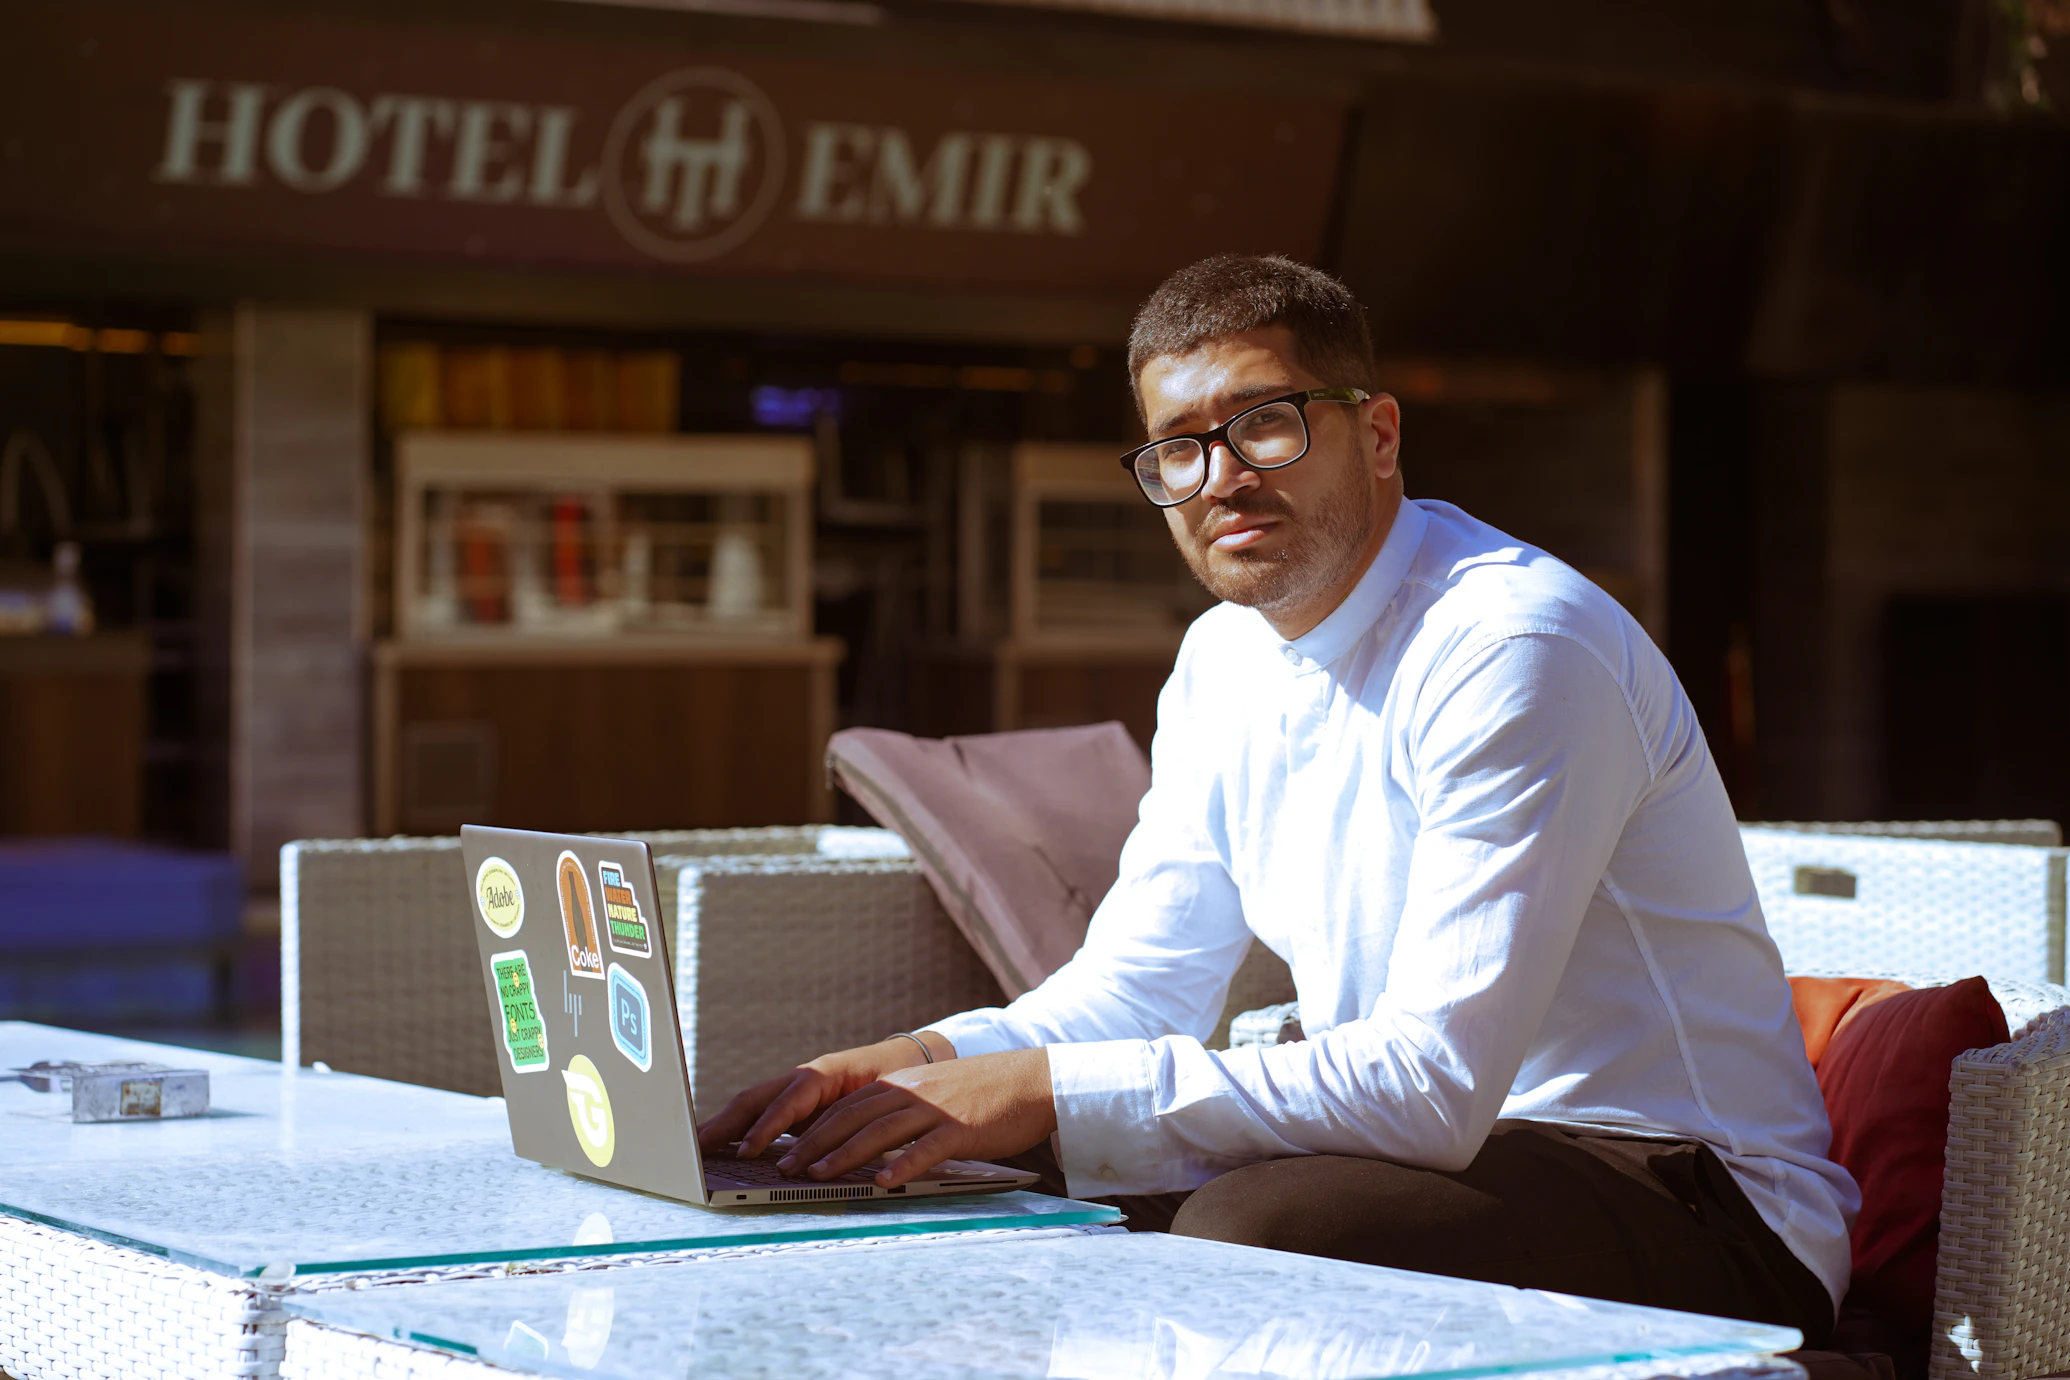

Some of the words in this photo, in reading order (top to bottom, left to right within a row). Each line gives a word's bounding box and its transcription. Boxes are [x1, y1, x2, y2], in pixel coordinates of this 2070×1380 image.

[153, 77, 601, 207] HOTEL
[794, 120, 1094, 236] EMIR
[602, 869, 621, 888] FIRE
[486, 885, 515, 910] Adobe
[605, 886, 633, 905] WATER
[607, 903, 638, 923] NATURE
[609, 919, 646, 940] THUNDER
[571, 944, 600, 969] Coke
[496, 966, 514, 981] THERE
[514, 963, 526, 977] ARE
[500, 985, 509, 998] NO
[509, 982, 530, 997] CRAPPY
[505, 1002, 535, 1024] FONTS
[621, 997, 638, 1036] Ps
[513, 1045, 544, 1060] DESIGNERS
